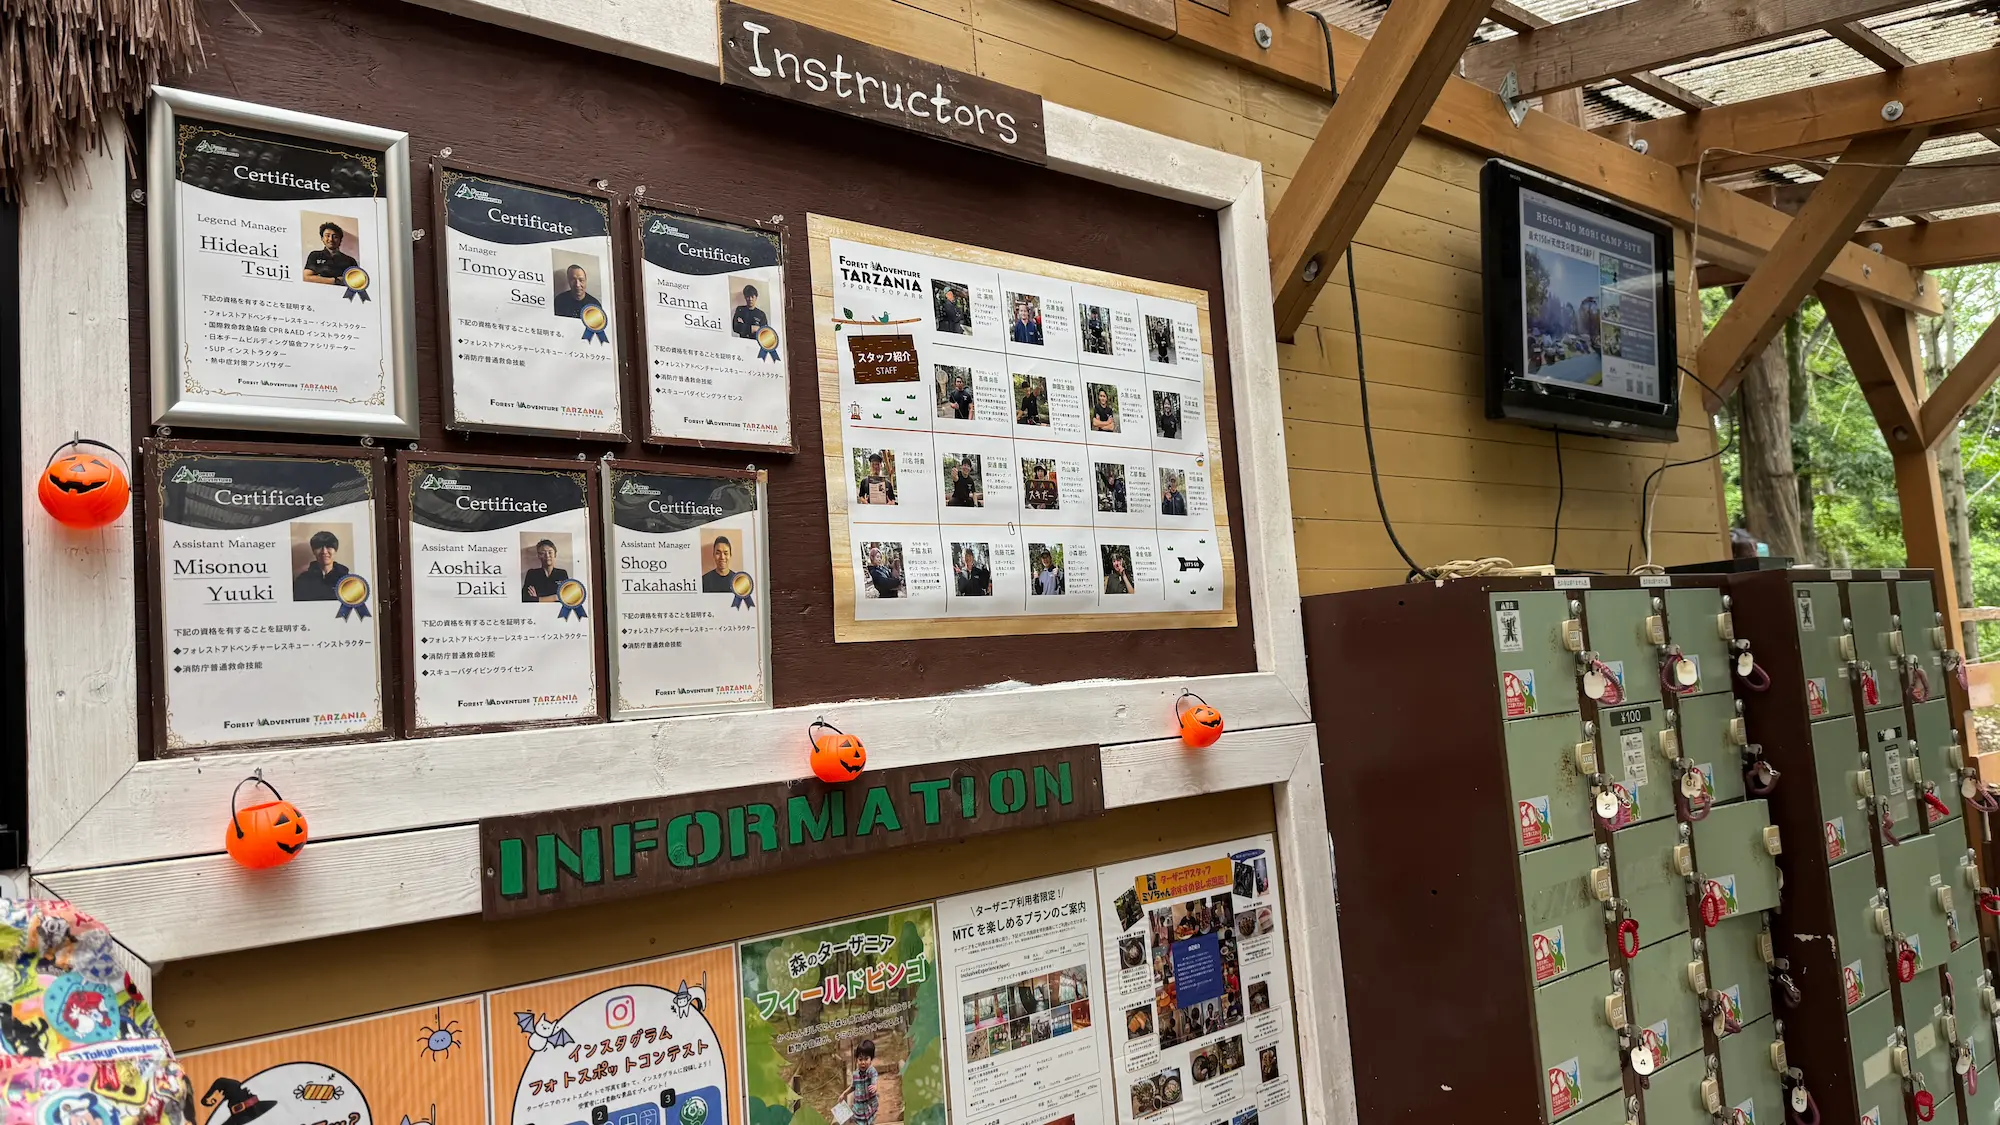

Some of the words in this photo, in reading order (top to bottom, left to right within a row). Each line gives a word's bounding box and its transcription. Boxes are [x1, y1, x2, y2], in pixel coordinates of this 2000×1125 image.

[743, 21, 1018, 144] Instructors
[233, 165, 331, 193] Certificate
[197, 213, 237, 228] Legend
[241, 219, 288, 234] Manager
[488, 208, 573, 236] Certificate
[1536, 211, 1563, 228] RESOL
[1565, 221, 1576, 233] NO
[1578, 225, 1599, 240] MORI
[1600, 234, 1622, 248] CAMP
[1624, 241, 1642, 254] SITE
[200, 234, 279, 258] Hideaki
[459, 243, 498, 257] Manager
[678, 242, 750, 266] Certificate
[241, 260, 291, 281] Tsuji
[459, 257, 545, 284] Tomoyasu
[839, 255, 869, 270] FOREST
[876, 262, 921, 278] ADVENTURE
[657, 278, 690, 291] Manager
[840, 267, 923, 293] TARZANIA
[511, 289, 546, 306] Sase
[658, 292, 709, 311] Ranma
[684, 313, 723, 330] Sakai
[209, 345, 226, 354] SUP
[227, 347, 287, 357] インストラクター
[857, 351, 912, 363] スタッフ紹介
[875, 366, 898, 375] STAFF
[561, 406, 604, 415] TARZANIA
[742, 422, 779, 431] TARZANIA
[214, 490, 324, 507] Certificate
[456, 495, 548, 513] Certificate
[648, 500, 723, 516] Certificate
[172, 539, 225, 549] Assistant
[228, 539, 276, 550] Manager
[421, 543, 464, 552] Assistant
[468, 544, 508, 554] Manager
[620, 540, 656, 549] Assistant
[658, 541, 691, 550] Manager
[173, 558, 268, 575] Misonou
[428, 561, 502, 575] Aoshika
[621, 556, 667, 573] Shogo
[207, 585, 274, 602] Yuuki
[456, 581, 506, 596] Daiki
[621, 578, 697, 592] Takahashi
[716, 684, 753, 692] TARZANIA
[533, 694, 578, 703] TARZANIA
[313, 711, 367, 722] TARZANIA
[1620, 709, 1641, 724] ¥100
[500, 760, 1075, 898] INFORMATION
[952, 925, 975, 942] MTC
[977, 900, 1087, 937] を楽しめるプランのご案内
[789, 933, 896, 978] 森のターザニア
[757, 954, 929, 1021] フィールドビンゴ
[568, 1025, 673, 1063] インスタグラム
[528, 1038, 710, 1096] フォトスポットコンテスト
[1640, 1058, 1646, 1066] 4
[664, 1094, 671, 1103] 3
[596, 1111, 604, 1120] 2
